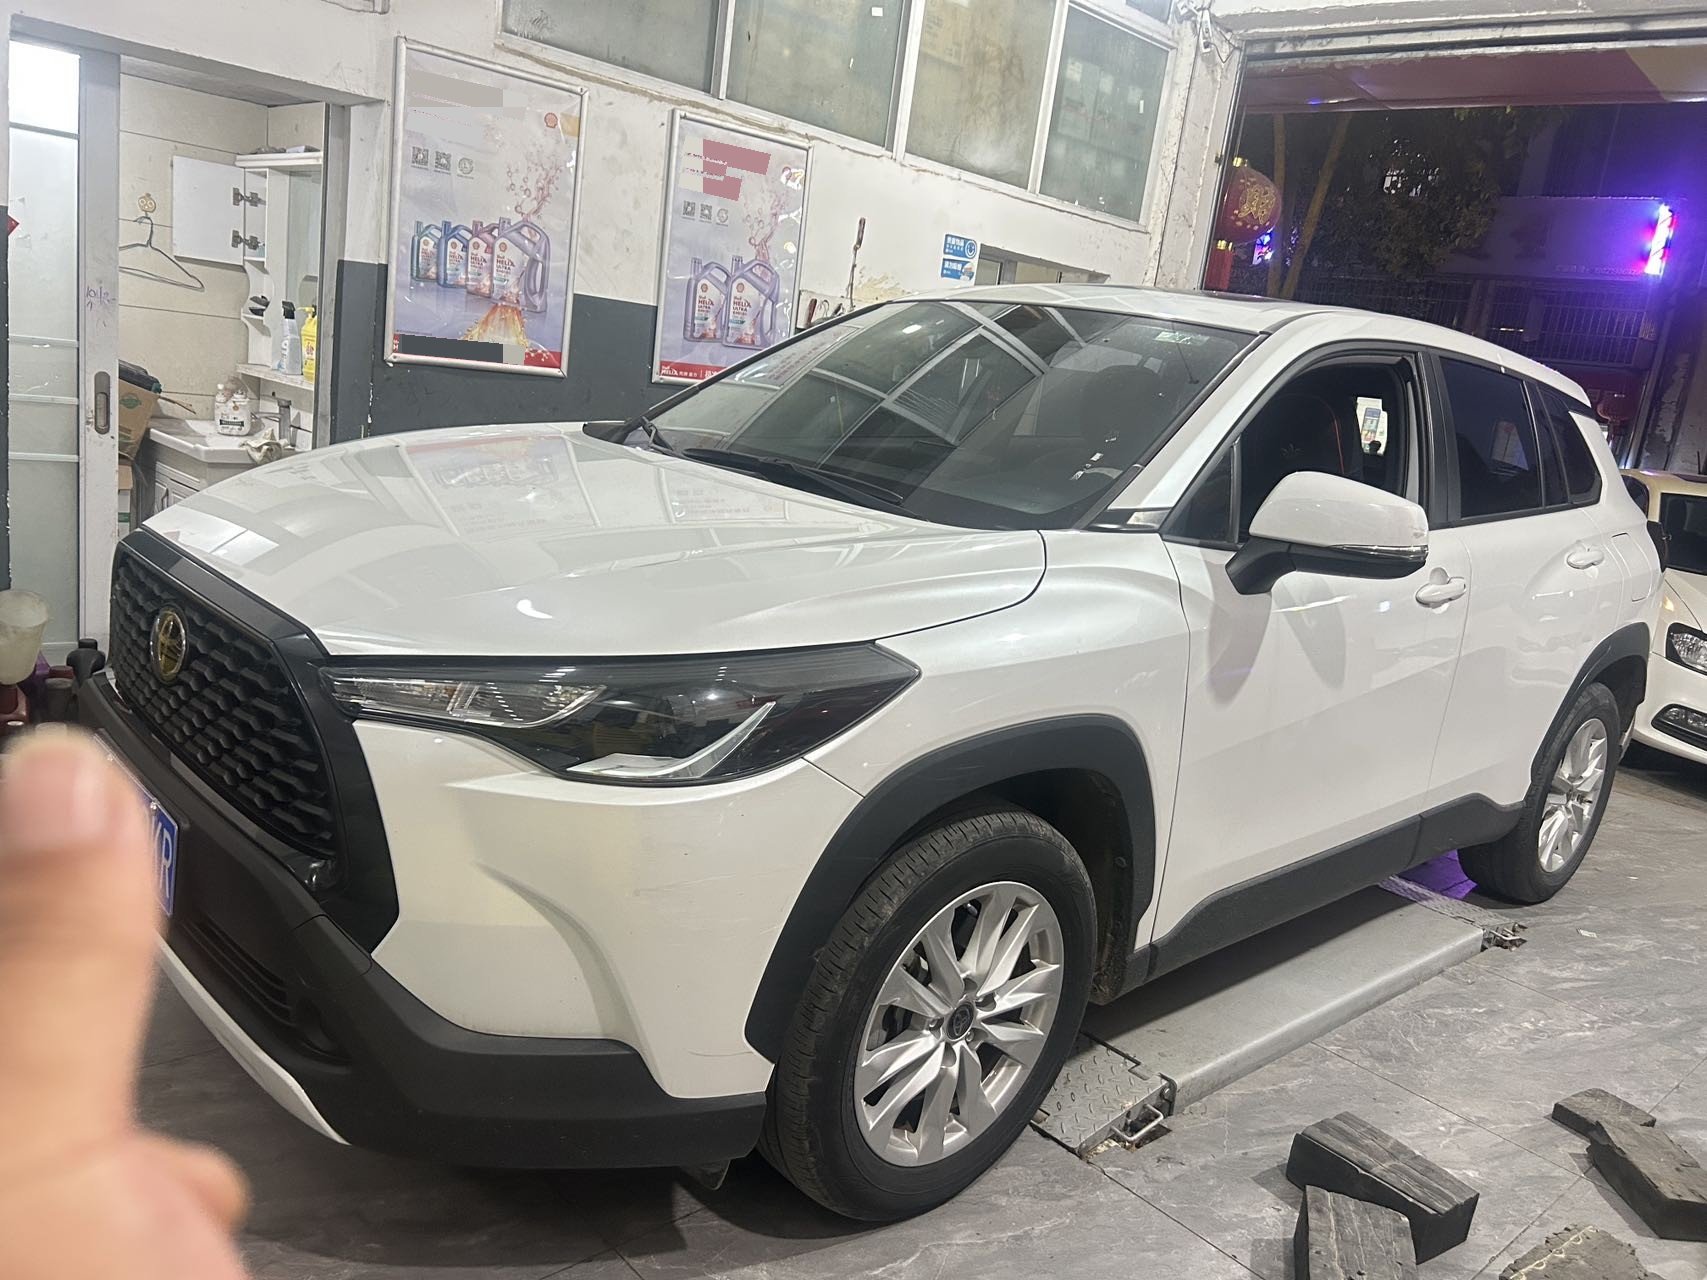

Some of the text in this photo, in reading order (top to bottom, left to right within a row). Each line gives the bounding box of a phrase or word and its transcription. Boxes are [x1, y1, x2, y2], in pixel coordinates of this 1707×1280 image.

[496, 258, 515, 267] HELIX
[733, 299, 752, 308] HELIX
[661, 367, 678, 376] HELIX
